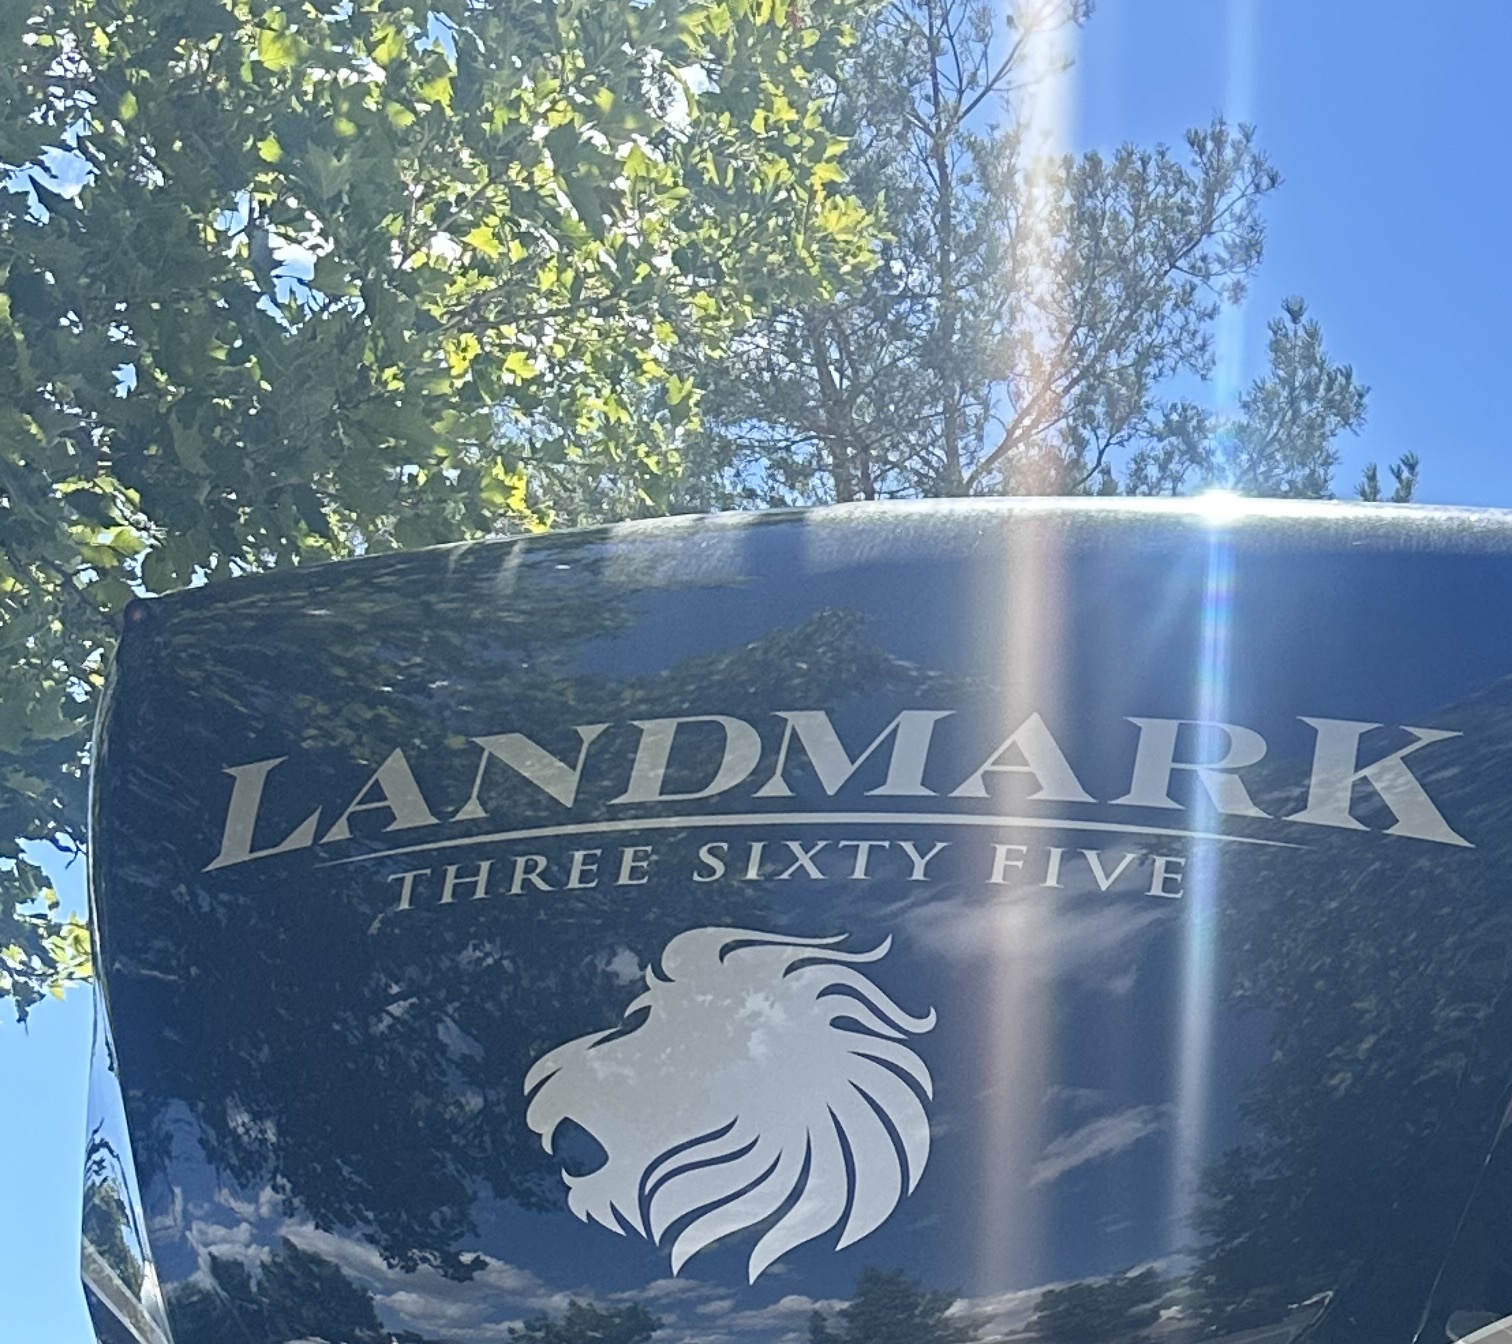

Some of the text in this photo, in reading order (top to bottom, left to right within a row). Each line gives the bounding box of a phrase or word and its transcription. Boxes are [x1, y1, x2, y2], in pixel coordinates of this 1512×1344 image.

[201, 709, 1476, 873] LANDMARK
[389, 840, 1187, 911] THREE SIXTY FIVE
